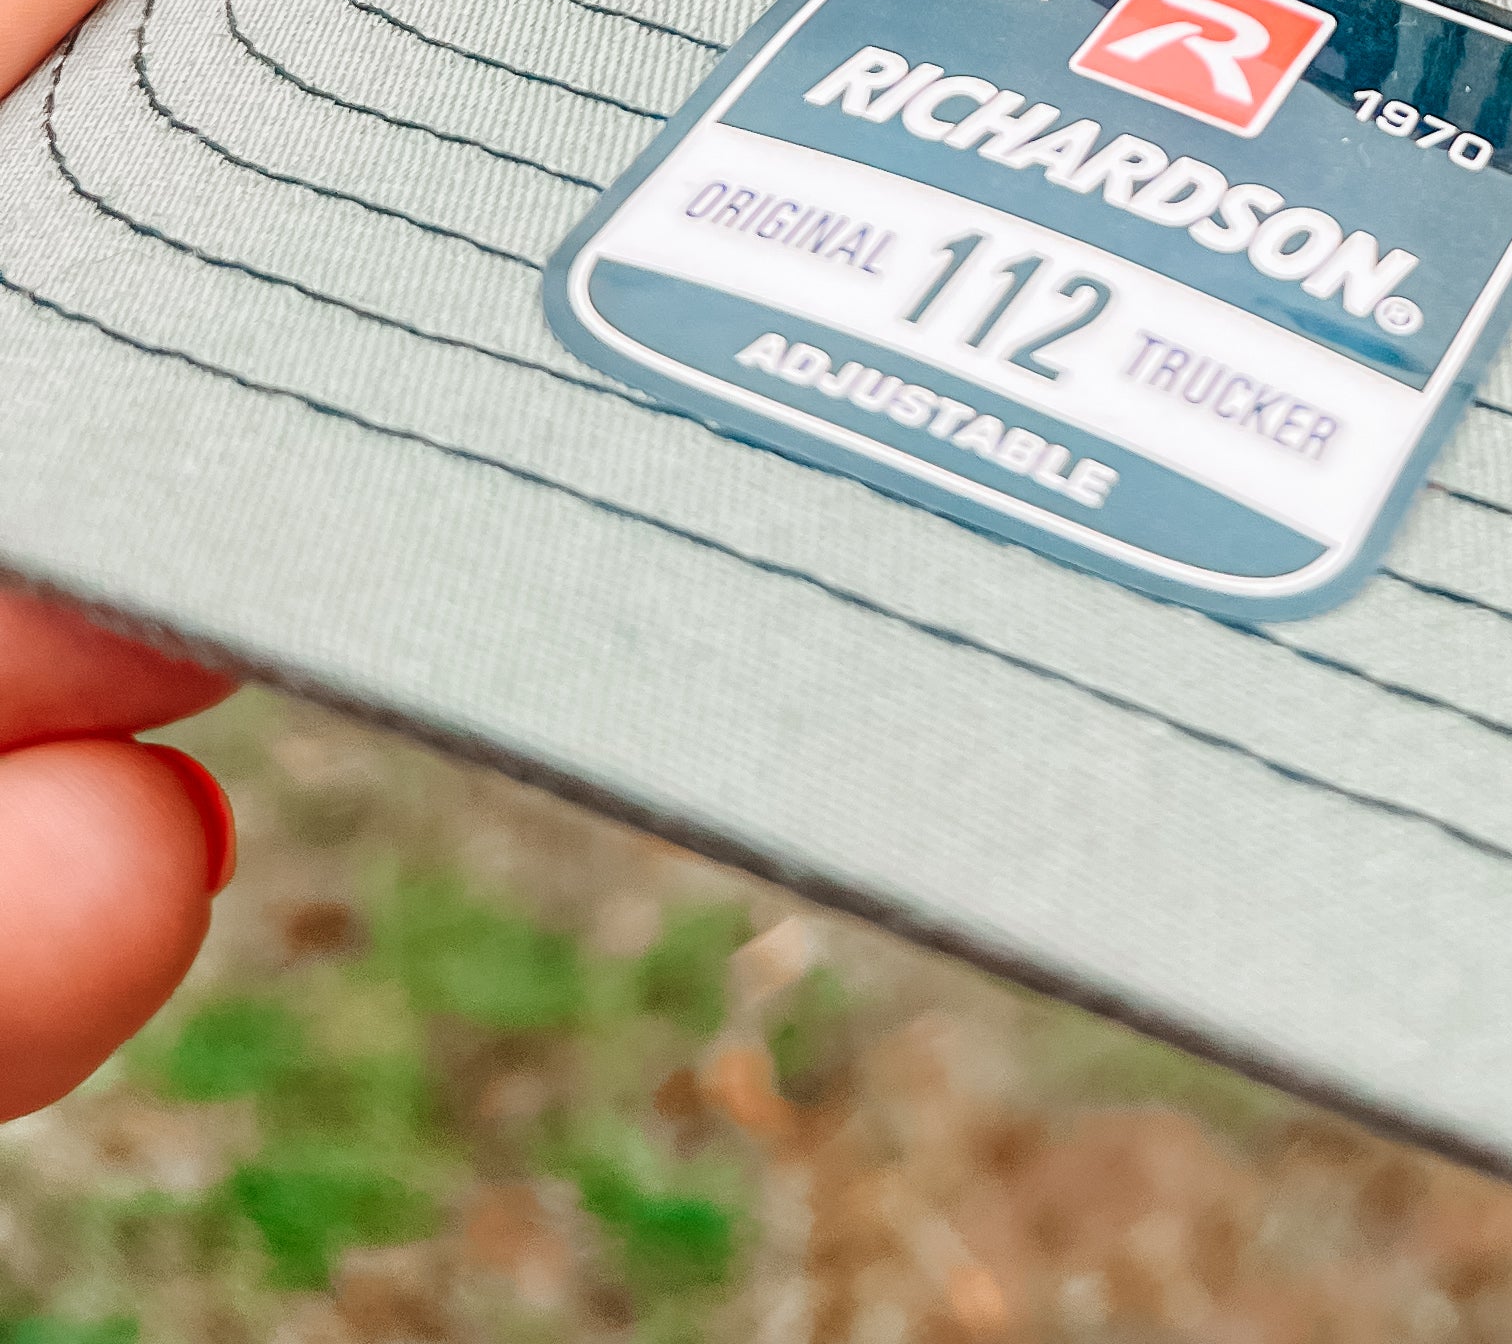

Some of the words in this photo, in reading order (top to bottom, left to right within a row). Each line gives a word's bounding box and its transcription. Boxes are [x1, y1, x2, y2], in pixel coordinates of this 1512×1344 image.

[1353, 87, 1493, 171] 1970
[684, 180, 896, 277] ORIGINAL
[901, 229, 1116, 381] 112
[1126, 329, 1338, 462] TRUCKER
[737, 330, 1119, 508] ADJUSTABLE
